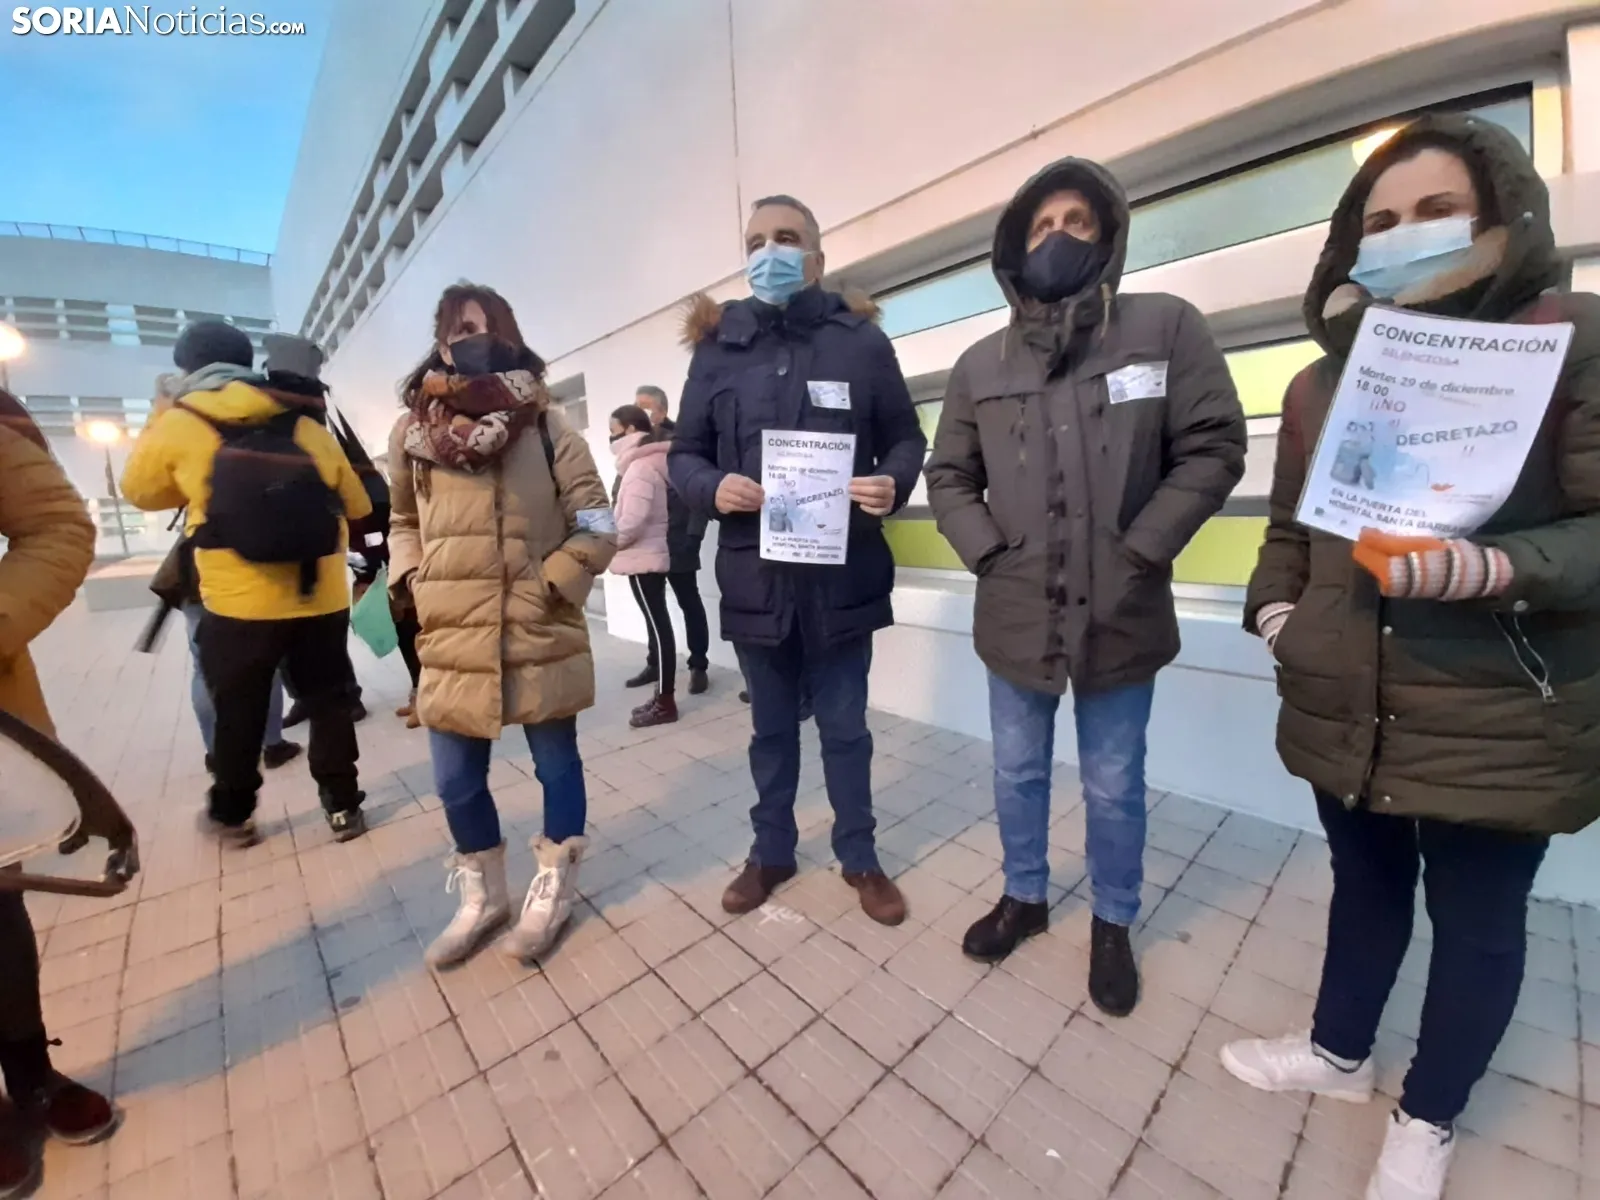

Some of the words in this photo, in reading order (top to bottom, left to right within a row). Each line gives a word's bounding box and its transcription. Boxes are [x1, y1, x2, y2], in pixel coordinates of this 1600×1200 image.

[1373, 323, 1558, 353] CONCENTRACIÓN
[1358, 365, 1397, 384] Martes
[1400, 376, 1416, 387] 29
[1419, 379, 1437, 391] de
[1441, 381, 1514, 397] diciembre
[768, 438, 851, 451] CONCENTRACIÓN
[1396, 420, 1518, 447] DECRETAZO
[796, 488, 844, 506] DECRETAZO
[1345, 491, 1357, 502] LA
[1359, 494, 1402, 514] PUERTA
[1376, 514, 1414, 528] SANTA
